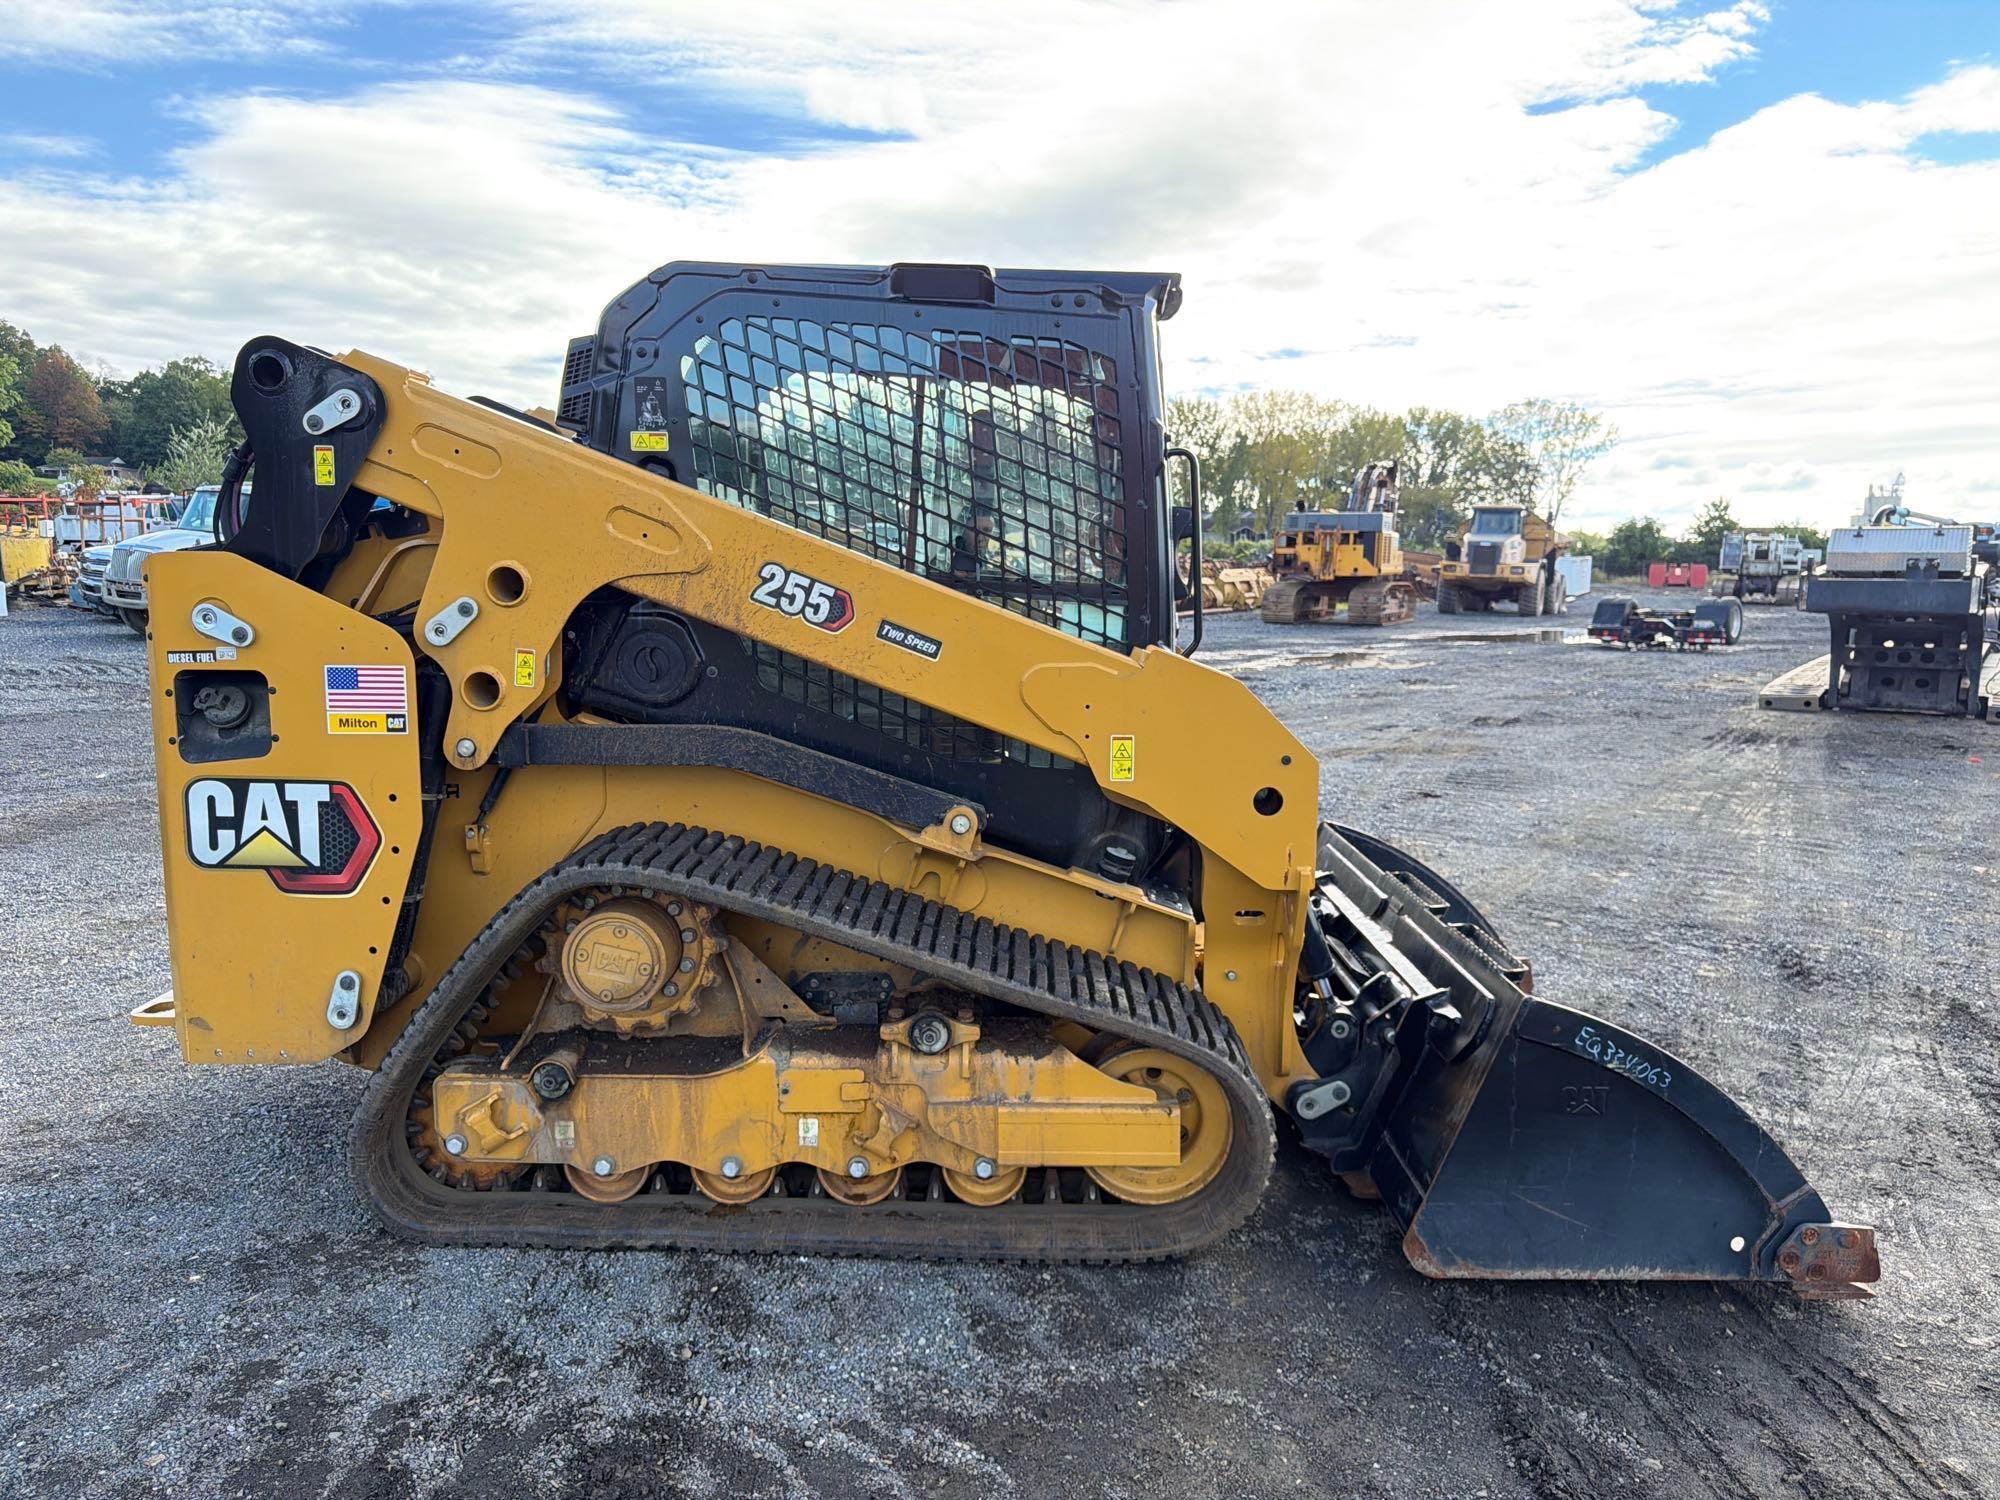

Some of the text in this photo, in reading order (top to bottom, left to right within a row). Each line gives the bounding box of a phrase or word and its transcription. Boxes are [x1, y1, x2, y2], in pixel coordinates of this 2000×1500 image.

[753, 563, 836, 623] 255
[168, 653, 194, 663] DIESEL
[196, 652, 216, 662] FUEL
[338, 718, 405, 729] Milton CAT
[188, 780, 330, 867] CAT
